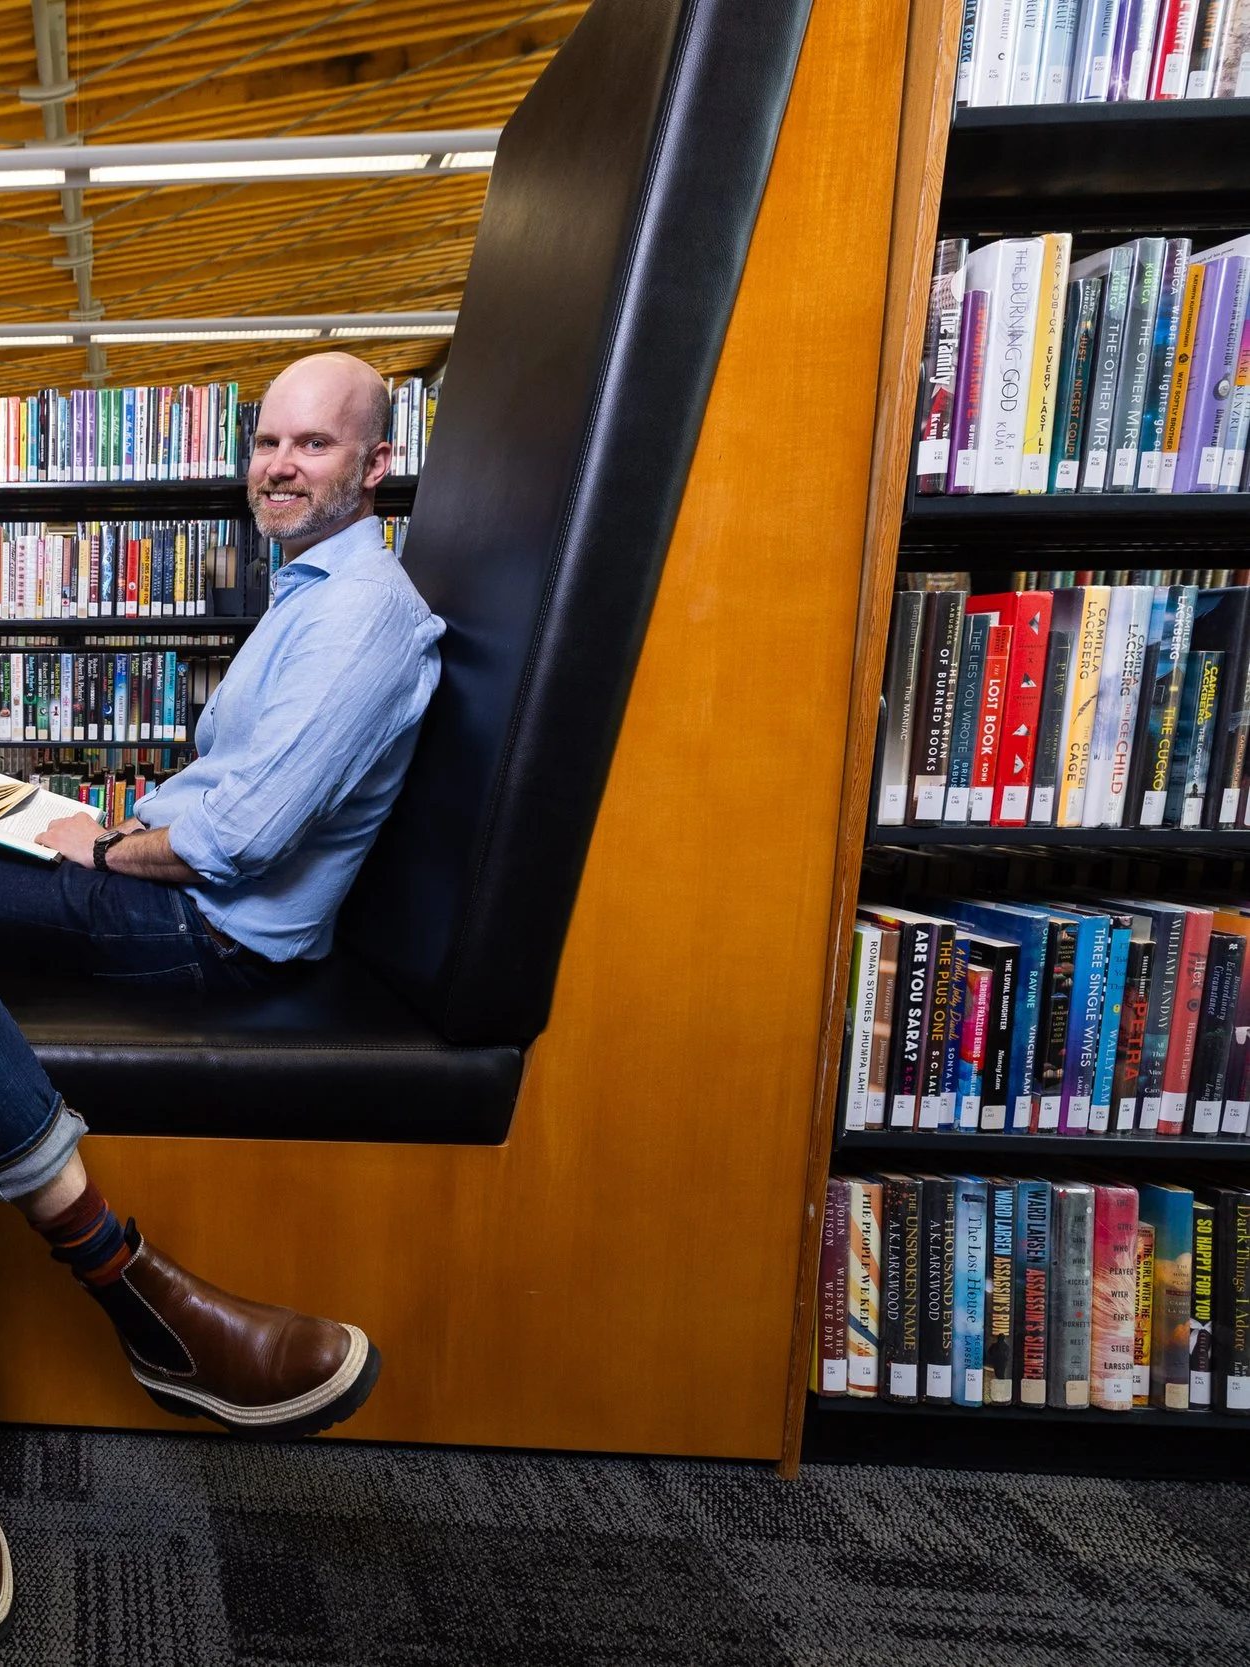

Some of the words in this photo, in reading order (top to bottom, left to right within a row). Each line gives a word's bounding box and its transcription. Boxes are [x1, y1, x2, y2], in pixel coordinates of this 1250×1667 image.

[1014, 249, 1028, 272] THE
[1054, 244, 1064, 278] MARY
[1170, 249, 1183, 296] KUBICA
[1109, 271, 1122, 311] KUBICA
[1141, 263, 1154, 304] KUBICA
[1005, 282, 1029, 361] BURNING
[1048, 285, 1060, 335] KUBICA
[1000, 369, 1021, 412] GOD
[1176, 371, 1184, 388] WAIT
[1172, 389, 1182, 418] SOFTLY
[1165, 418, 1177, 450] BROTHER
[939, 648, 950, 665] OF
[969, 629, 982, 652] THE
[1091, 607, 1108, 674] CAMILLA
[949, 661, 958, 685] THE
[967, 654, 979, 679] LIES
[1132, 634, 1146, 686] CAMILLA
[932, 672, 947, 722] BURNED
[963, 683, 975, 708] YOU
[986, 679, 1000, 710] LOST
[1203, 665, 1219, 720] CAMILLA
[900, 702, 910, 741] MANIAC
[939, 692, 955, 759] LIBRARIAN
[957, 711, 973, 753] WROTE
[980, 715, 997, 756] BOOK
[926, 729, 941, 772] BOOKS
[1066, 742, 1081, 782] CAGE
[912, 930, 930, 963] ARE
[938, 940, 953, 966] THE
[955, 946, 962, 956] A
[1091, 927, 1106, 969] THREE
[1164, 918, 1182, 978] WILLIAM
[952, 956, 966, 985] Holly
[1005, 958, 1013, 973] THE
[1192, 959, 1207, 986] Her
[909, 968, 925, 1003] YOU
[935, 971, 950, 1005] PLUS
[1002, 973, 1012, 993] LOYAL
[1026, 970, 1039, 1010] RAVINE
[1085, 973, 1101, 1021] SINGLE
[999, 993, 1010, 1031] DAUGHTER
[1157, 980, 1174, 1030] LANDAY
[904, 1007, 923, 1062] SARA?
[931, 1009, 947, 1042] ONE
[1125, 1001, 1148, 1082] PETRA
[1025, 1024, 1037, 1069] VINCENT
[1080, 1024, 1095, 1068] WIVES
[1105, 1028, 1118, 1071] WALLY
[1022, 1070, 1033, 1096] LAM
[1100, 1071, 1112, 1107] LAM
[861, 1192, 872, 1218] THE
[908, 1191, 917, 1212] THE
[994, 1189, 1013, 1222] WARD
[837, 1203, 846, 1236] JOHN
[967, 1214, 983, 1243] The
[1196, 1218, 1212, 1235] SO
[860, 1222, 872, 1272] PEOPLE
[993, 1222, 1013, 1255] LARSEN
[1113, 1245, 1128, 1253] WHO
[1144, 1243, 1153, 1258] THE
[1196, 1234, 1212, 1268] HAPPY
[903, 1215, 918, 1301] UNSPOKEN
[966, 1243, 982, 1274] Lost
[1109, 1267, 1134, 1276] PLAYED
[1143, 1260, 1153, 1280] GIRL
[860, 1274, 871, 1295] WE
[992, 1256, 1012, 1313] ASSASSIN'S
[1110, 1290, 1129, 1299] WITH
[1142, 1281, 1152, 1302] WITH
[1196, 1269, 1211, 1294] FOR
[824, 1281, 834, 1321] WE'RE
[965, 1278, 981, 1324] House
[1141, 1303, 1150, 1319] THE
[1195, 1295, 1211, 1321] YOU
[903, 1304, 917, 1351] NAME
[991, 1313, 1010, 1336] RUN
[1113, 1314, 1128, 1322] FIRE
[824, 1324, 834, 1350] DRY
[1111, 1345, 1130, 1353] STIEG
